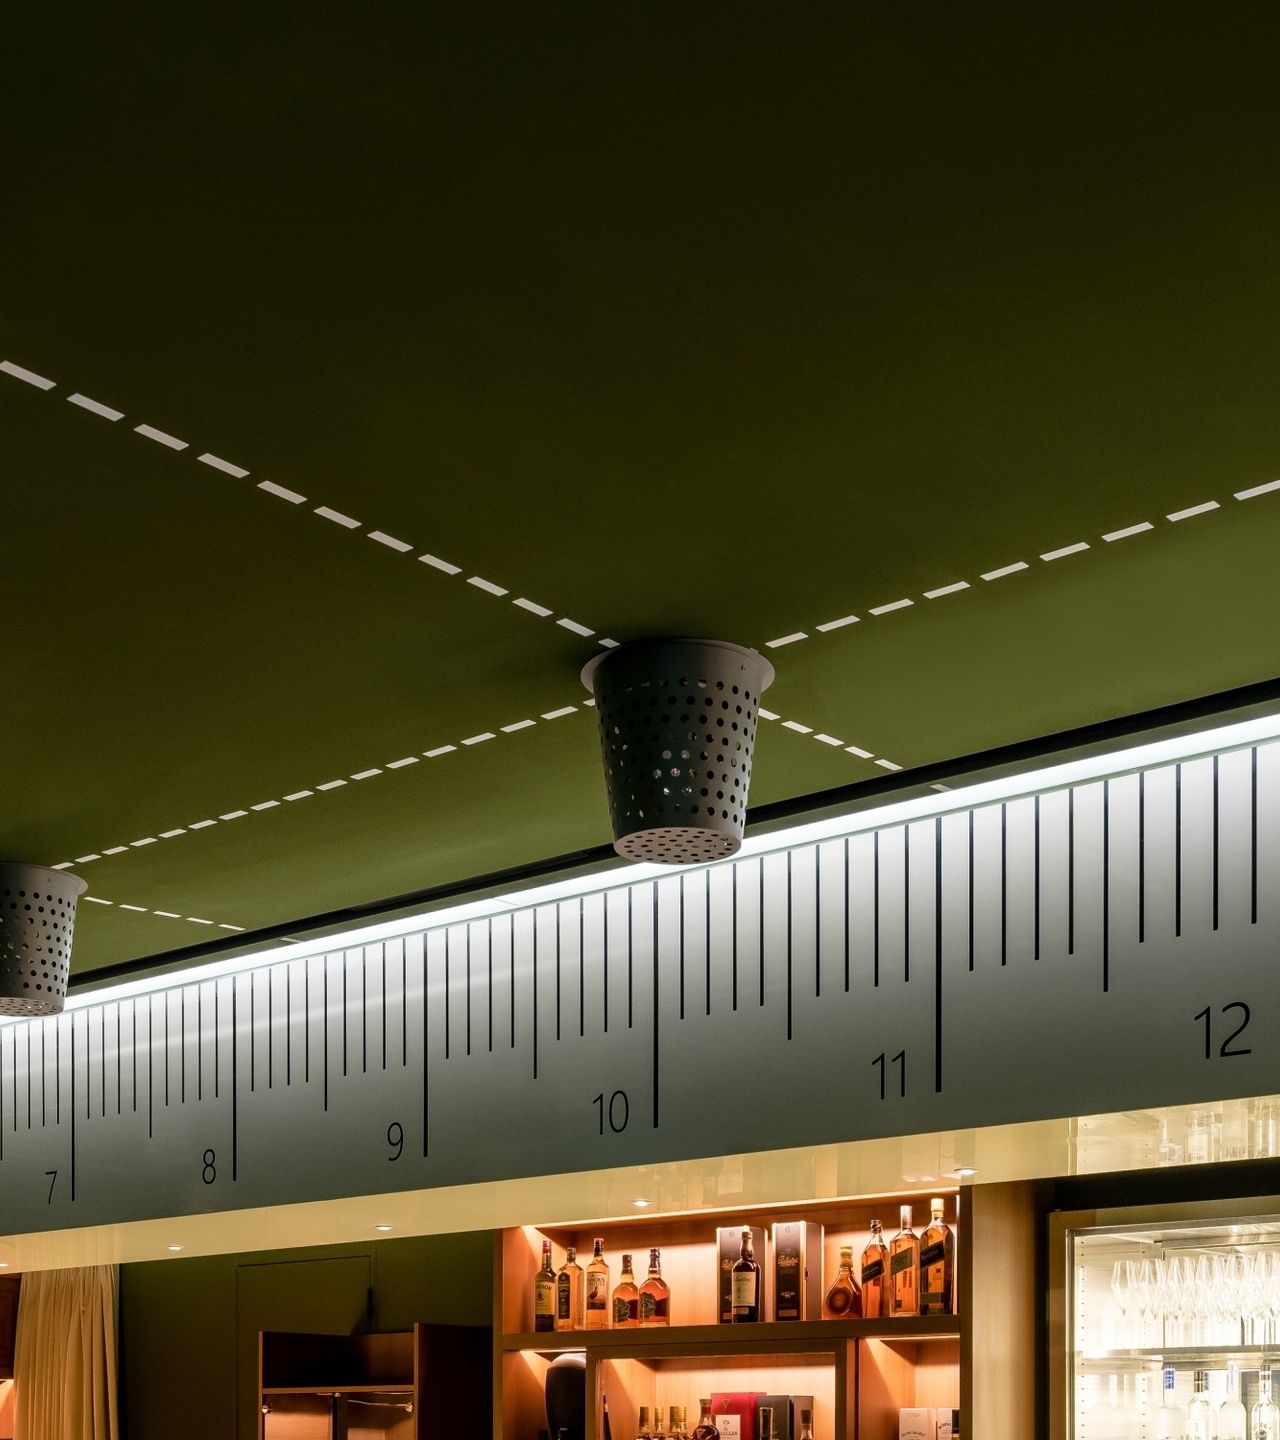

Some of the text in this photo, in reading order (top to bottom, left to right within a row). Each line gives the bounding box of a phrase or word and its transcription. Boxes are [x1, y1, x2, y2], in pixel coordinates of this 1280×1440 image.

[1193, 1001, 1252, 1060] 12
[871, 1049, 906, 1100] 11
[592, 1090, 630, 1136] 10
[387, 1121, 404, 1162] 9
[45, 1170, 58, 1205] 7
[202, 1148, 217, 1185] 8
